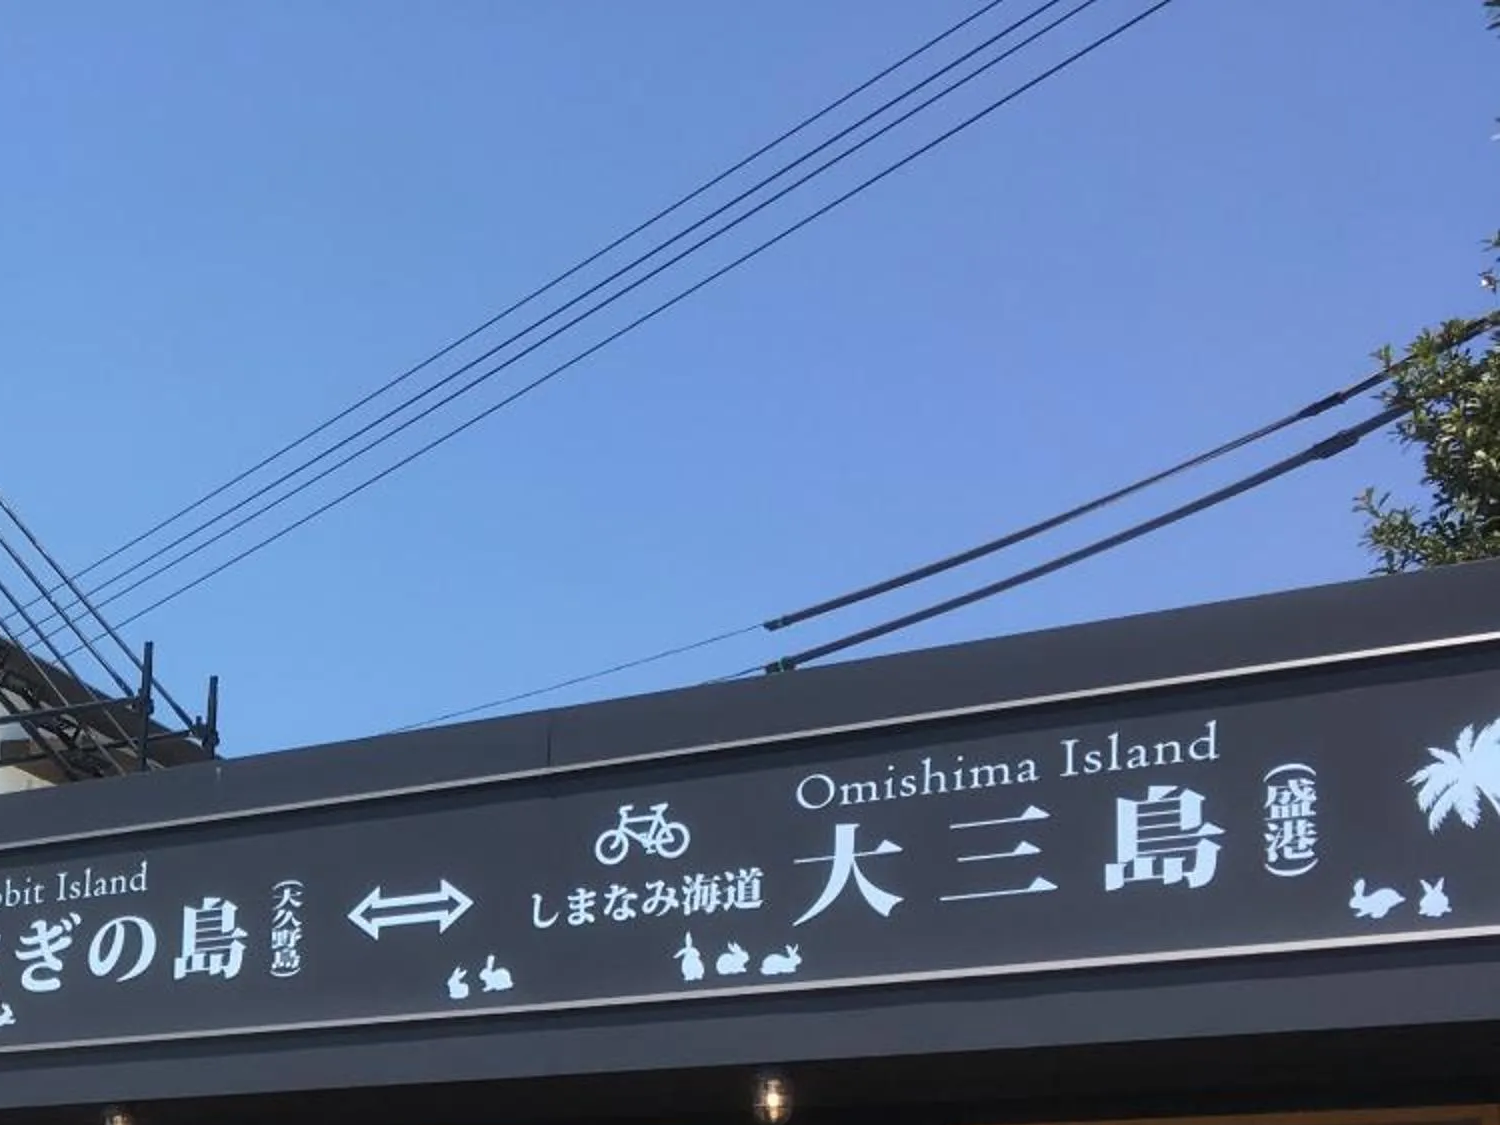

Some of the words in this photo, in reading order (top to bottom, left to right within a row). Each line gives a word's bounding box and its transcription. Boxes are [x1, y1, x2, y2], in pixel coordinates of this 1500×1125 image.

[795, 756, 1040, 811] Omishima
[1060, 719, 1220, 777] Island
[57, 861, 148, 902] Island
[793, 784, 1225, 926] 大三島
[531, 866, 765, 930] しまなみ海道
